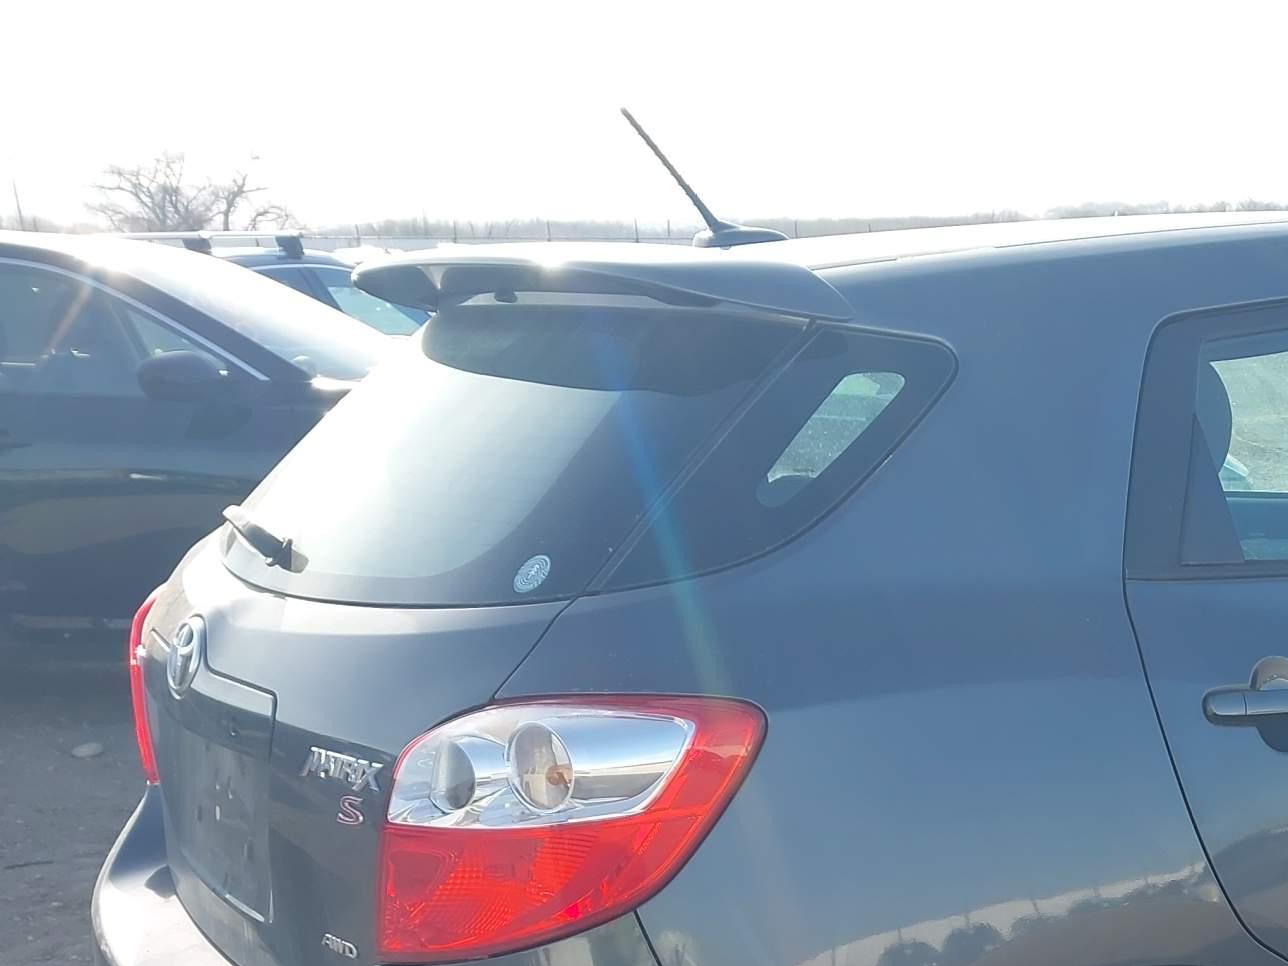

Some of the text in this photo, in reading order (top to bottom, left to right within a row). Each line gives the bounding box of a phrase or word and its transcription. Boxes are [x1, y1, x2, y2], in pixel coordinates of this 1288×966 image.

[300, 746, 384, 792] MATRIX
[336, 795, 364, 825] S
[320, 933, 358, 959] AWD
